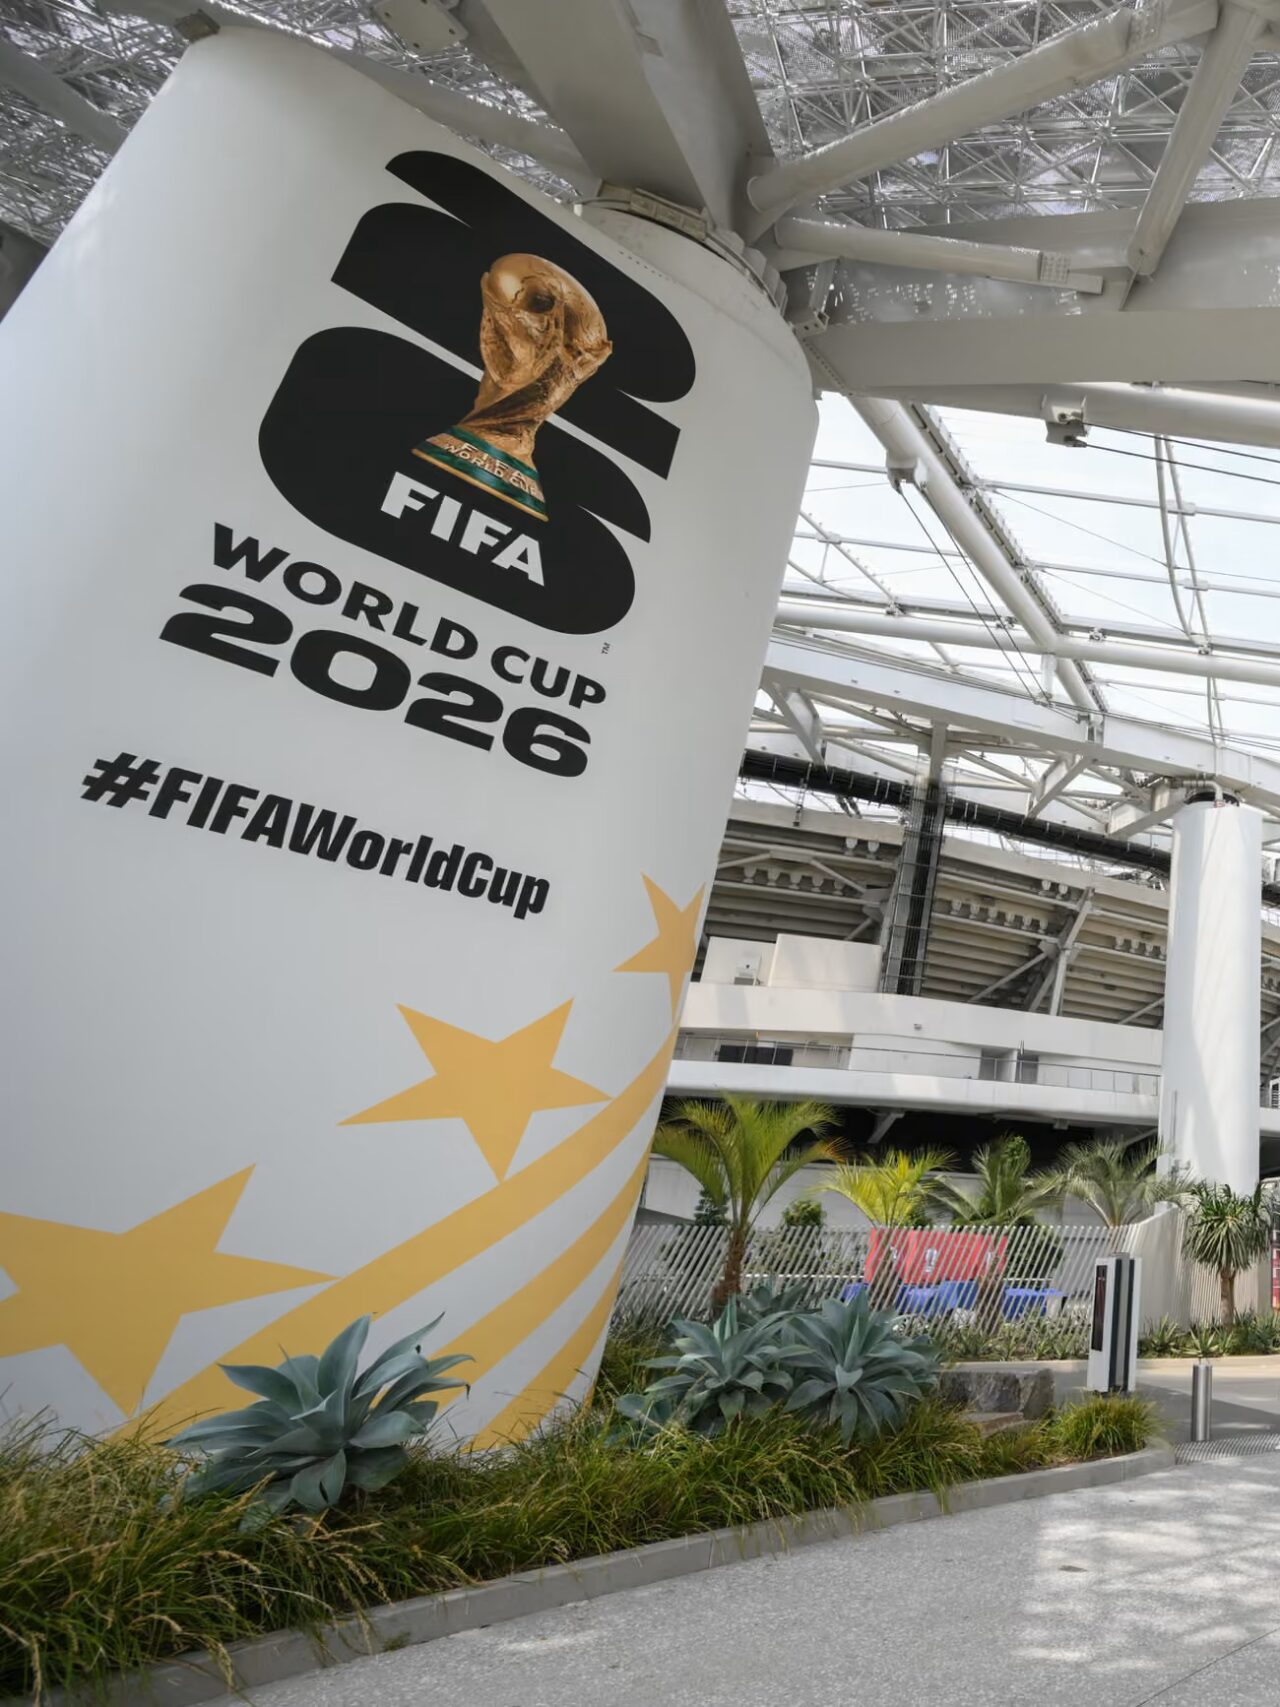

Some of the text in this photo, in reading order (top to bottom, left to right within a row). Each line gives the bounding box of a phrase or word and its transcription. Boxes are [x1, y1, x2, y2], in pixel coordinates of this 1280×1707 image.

[212, 522, 607, 710] WORLD CUP
[380, 471, 546, 587] FIFA
[158, 583, 591, 778] 2026
[80, 752, 551, 920] #FIFAWorldCup
